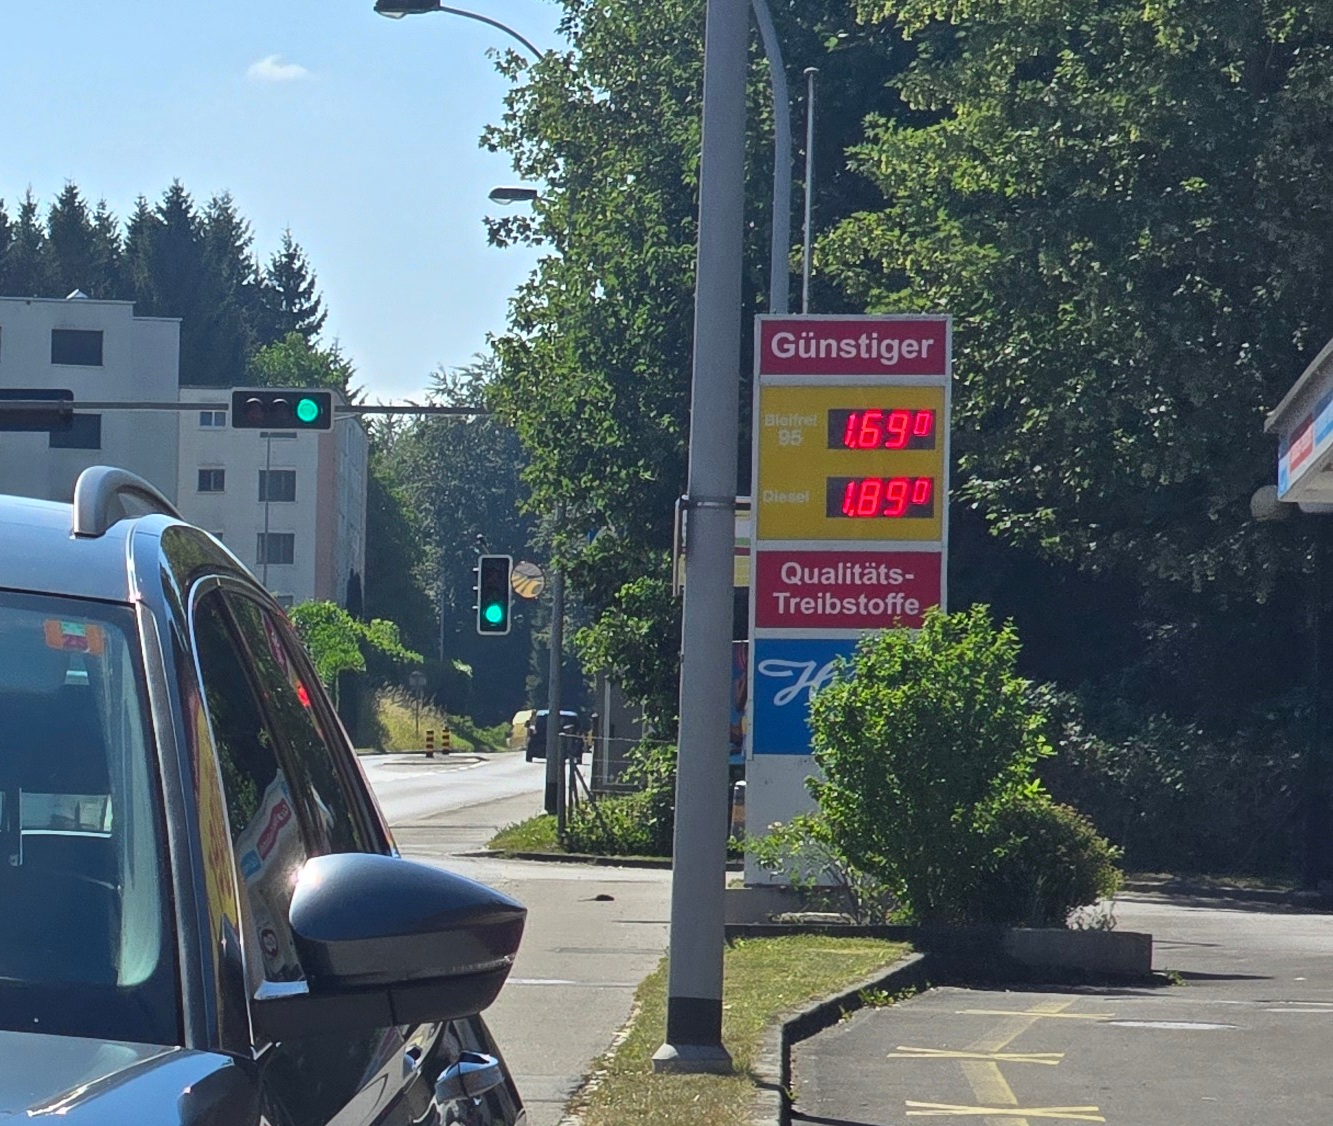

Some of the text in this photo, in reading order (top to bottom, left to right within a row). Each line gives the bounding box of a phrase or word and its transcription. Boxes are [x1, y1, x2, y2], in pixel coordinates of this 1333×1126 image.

[771, 332, 934, 366] Günstiger
[781, 561, 915, 587] Qualitäts-
[773, 591, 920, 616] Treibstoffe
